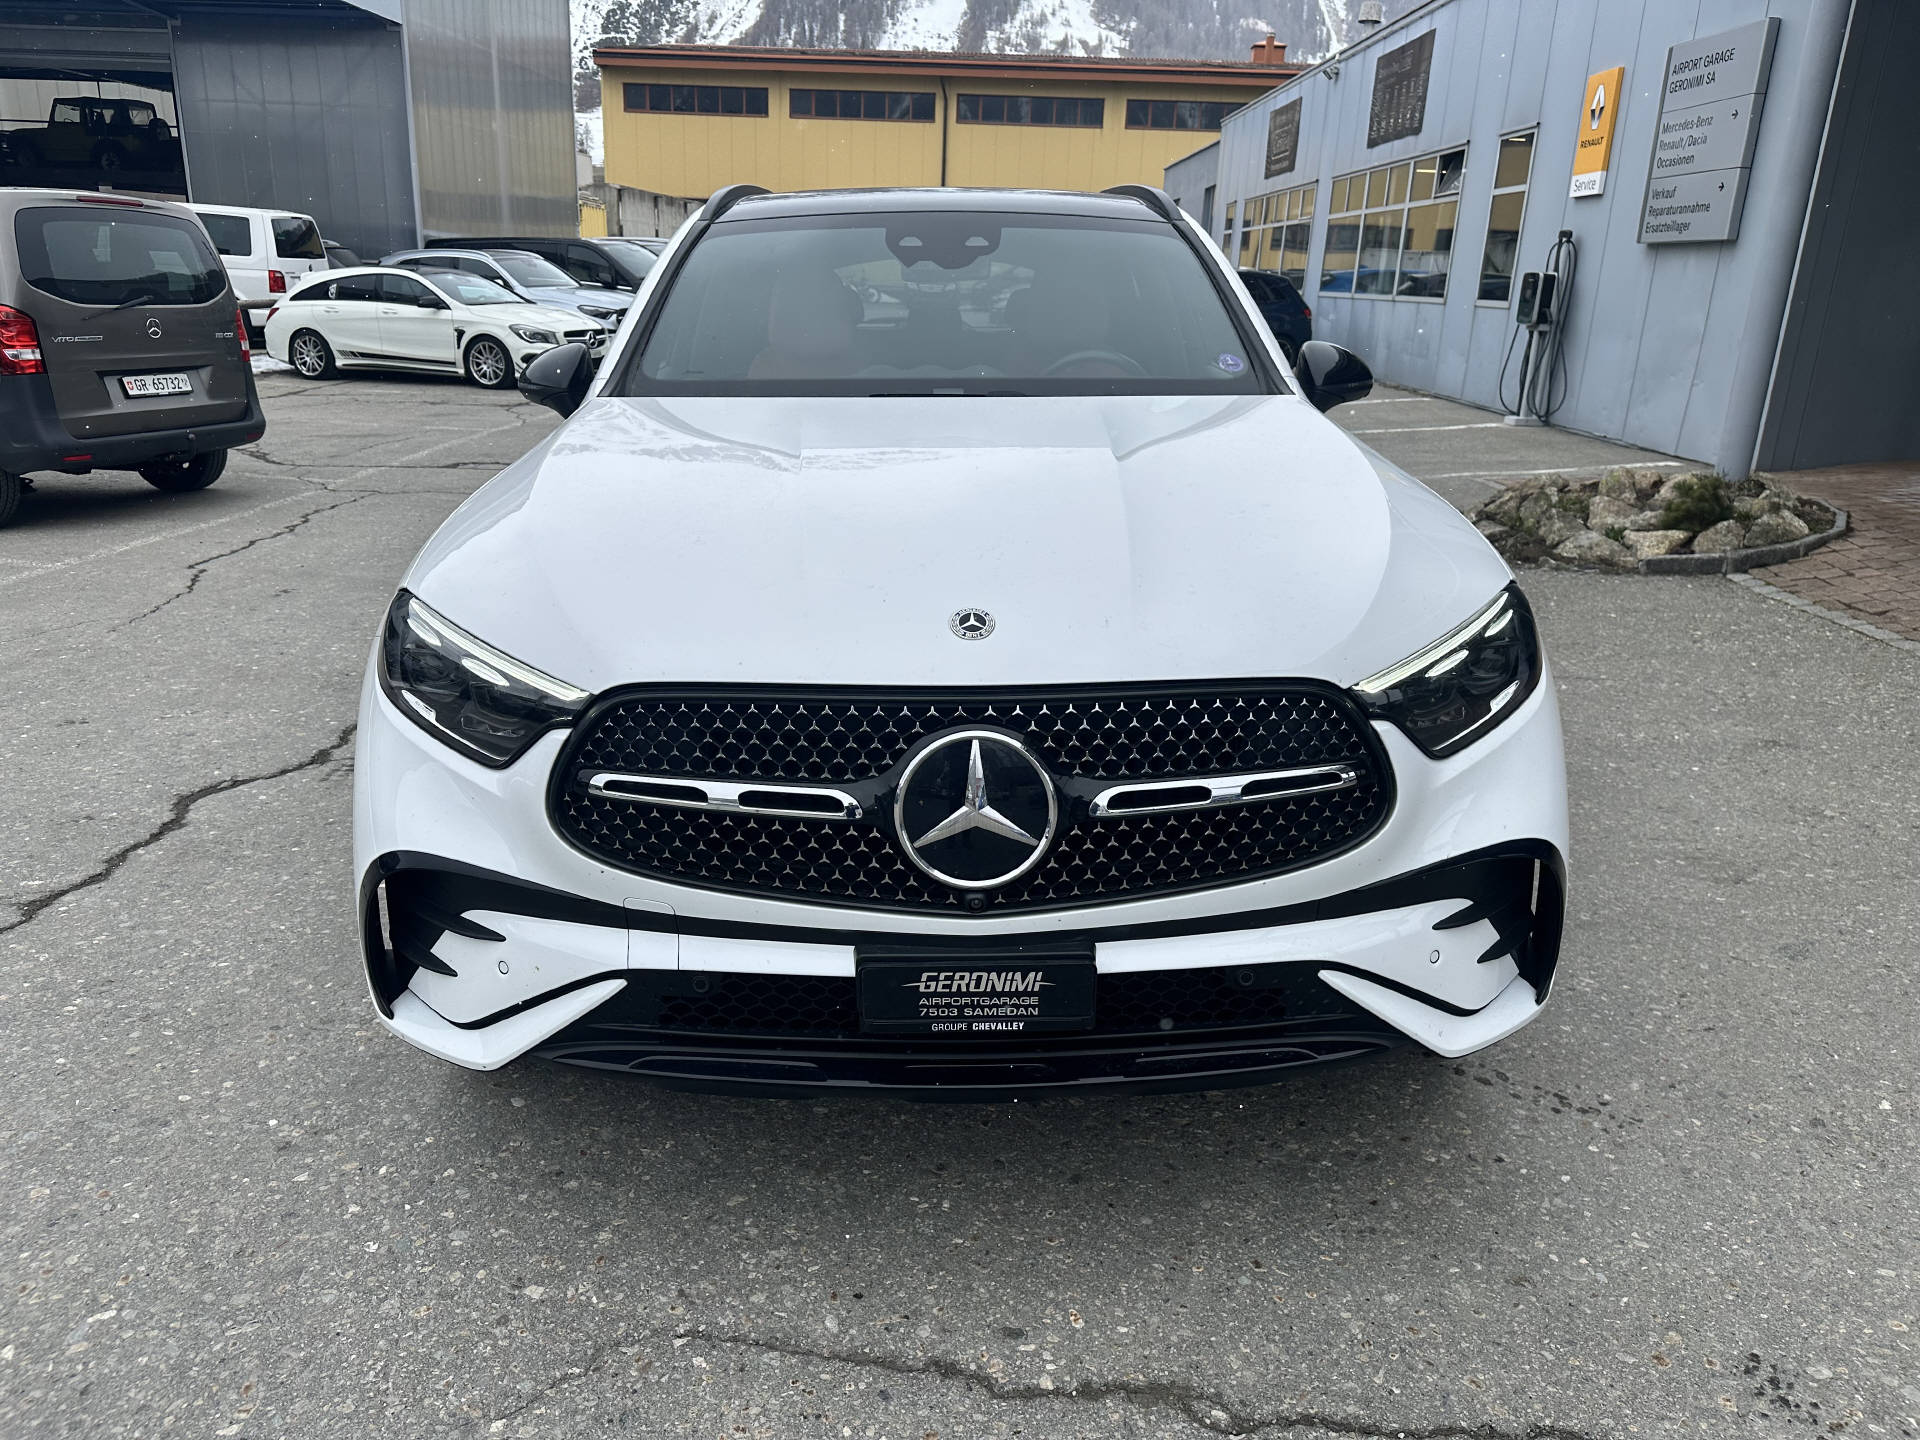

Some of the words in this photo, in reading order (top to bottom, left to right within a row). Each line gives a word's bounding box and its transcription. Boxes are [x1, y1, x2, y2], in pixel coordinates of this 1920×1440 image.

[1672, 57, 1703, 76] AIRPORT
[1704, 48, 1735, 68] GARAGE
[1669, 74, 1704, 93] GERONIMI
[1705, 70, 1716, 85] SA
[1661, 115, 1714, 135] Mercedes-Benz
[1580, 136, 1604, 149] RENAULT
[1659, 132, 1708, 151] Renault/Dacia
[1656, 154, 1695, 169] Occasionen
[1573, 178, 1596, 192] Service
[1651, 185, 1677, 200] Verkauf
[1647, 201, 1711, 219] Reparaturannahme
[134, 379, 149, 392] GR
[153, 377, 182, 391] 65732
[918, 971, 1043, 993] GERONIMI
[918, 996, 1039, 1006] AIRPORTGARAGE
[919, 1008, 958, 1016] 7503
[963, 1007, 1039, 1016] SAMEDAN
[931, 1022, 968, 1031] GROUPE
[972, 1021, 1025, 1031] CHEVALLEY
